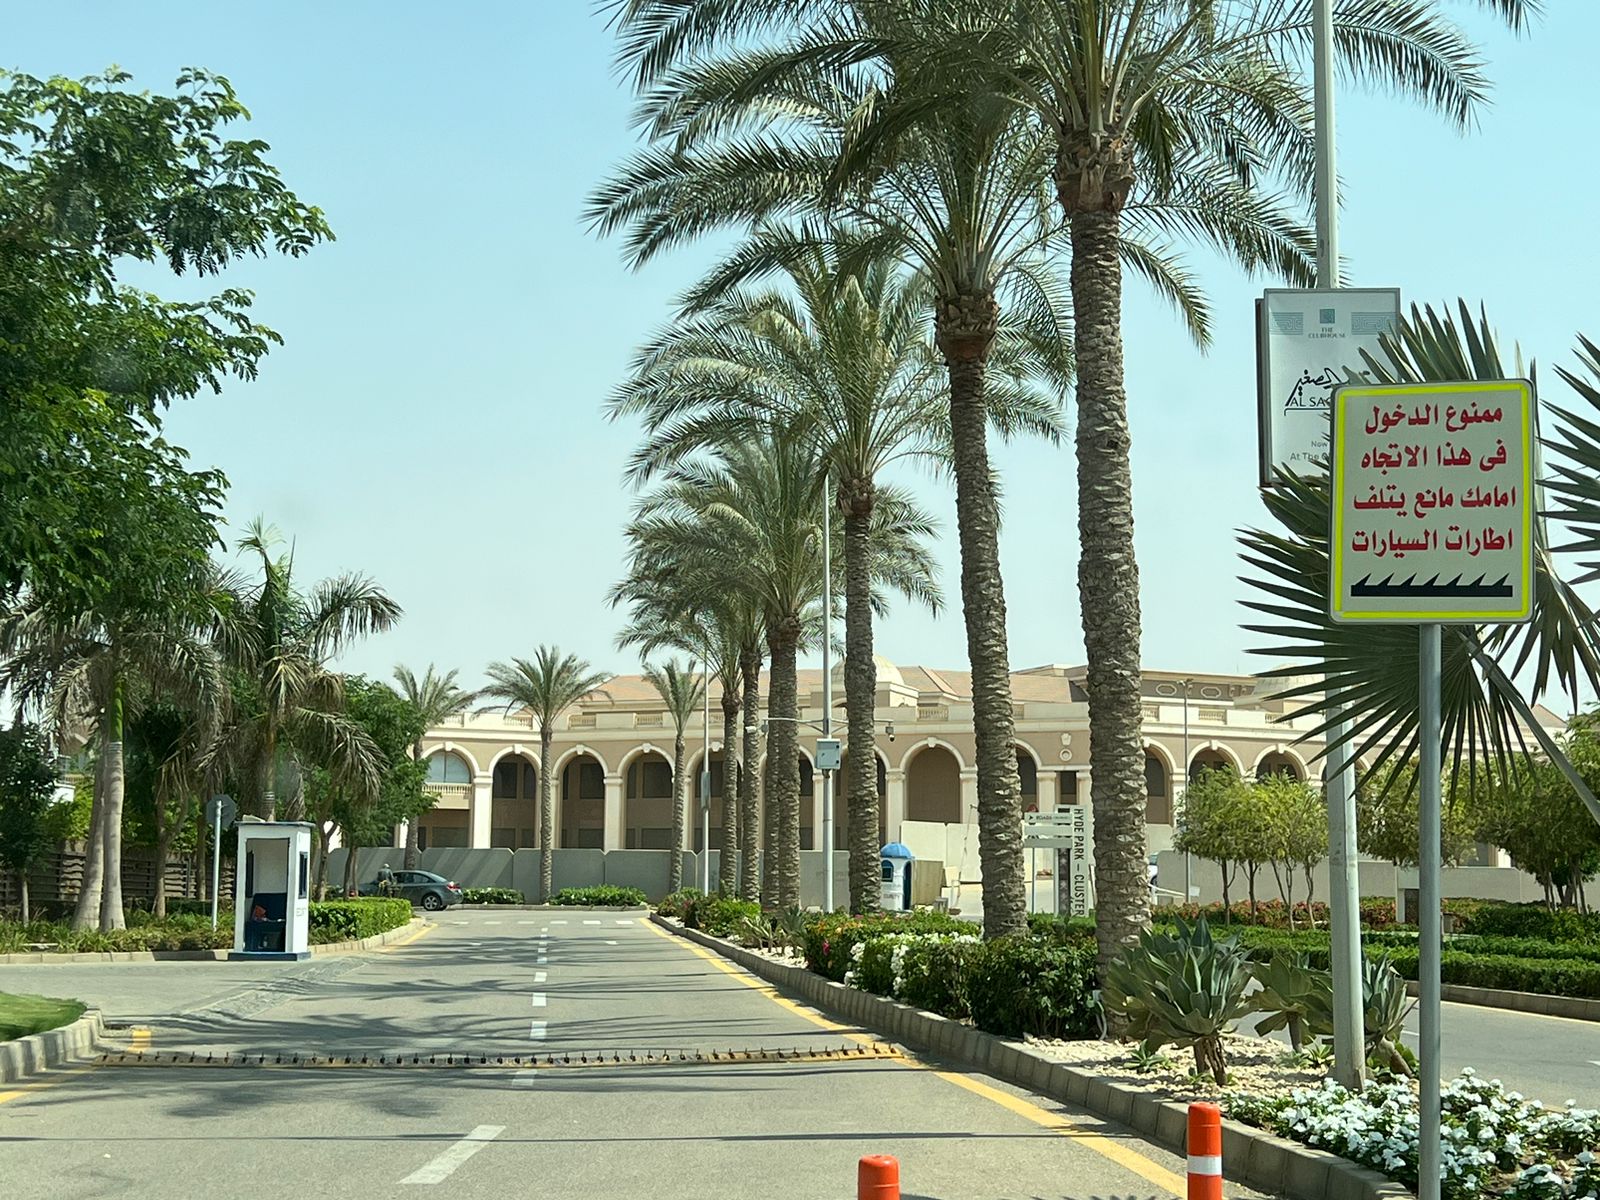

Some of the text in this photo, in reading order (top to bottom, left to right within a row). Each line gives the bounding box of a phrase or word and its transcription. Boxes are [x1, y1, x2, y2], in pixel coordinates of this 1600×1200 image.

[1290, 397, 1307, 407] AL
[1365, 402, 1503, 434] ممنوع الدخول
[1361, 443, 1428, 475] الاتجاه
[1437, 442, 1472, 466] هذا
[1353, 484, 1516, 518] امامك مانع يتلف
[1352, 525, 1514, 558] اطارات السيارات
[1073, 808, 1084, 833] HYDE
[1073, 836, 1084, 860] PARK
[1074, 874, 1085, 916] CLUSTER
